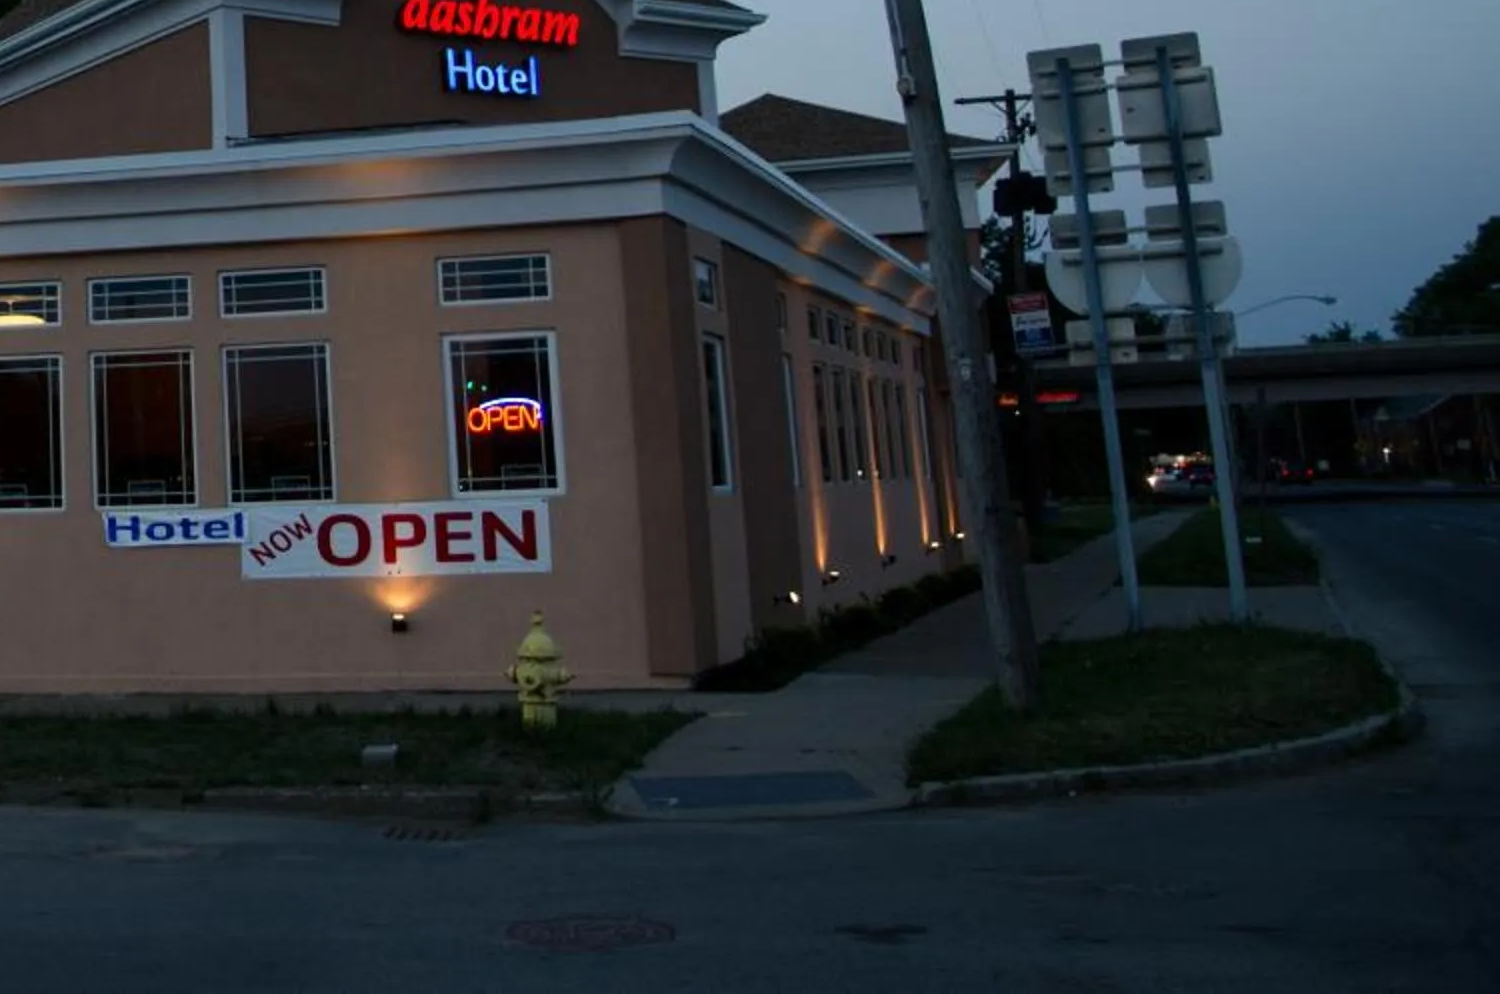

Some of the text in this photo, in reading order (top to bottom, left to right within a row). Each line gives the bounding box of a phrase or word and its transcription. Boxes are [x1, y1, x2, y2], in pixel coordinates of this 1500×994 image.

[446, 47, 539, 95] Hotel
[467, 405, 540, 432] OPEN
[106, 512, 245, 543] Hotel
[248, 509, 539, 567] NOW OPEN
